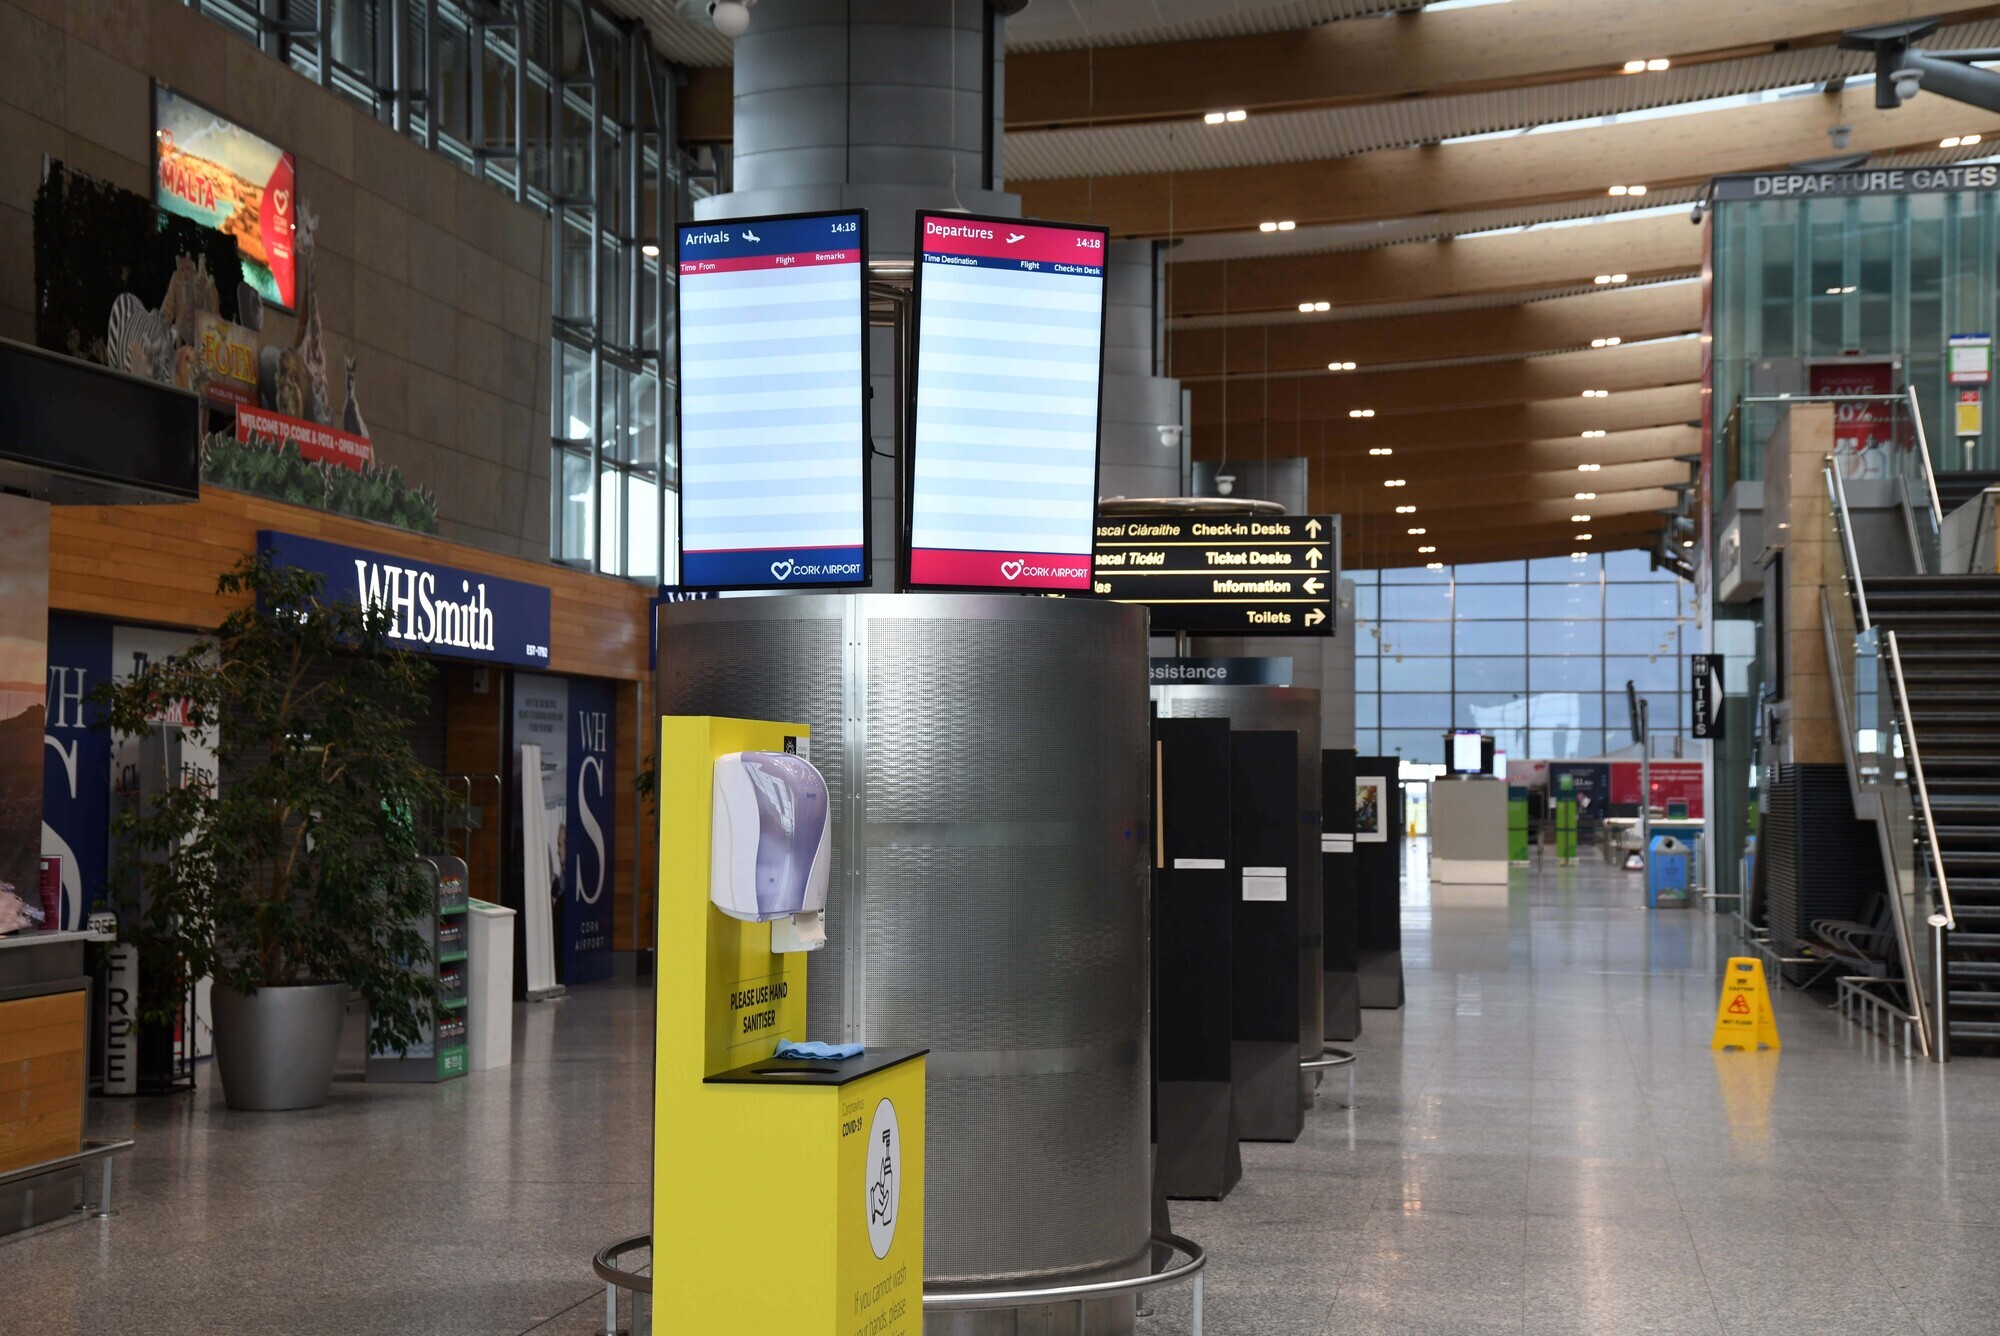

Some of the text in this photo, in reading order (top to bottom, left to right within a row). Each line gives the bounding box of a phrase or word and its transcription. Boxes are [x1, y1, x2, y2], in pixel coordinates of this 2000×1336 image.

[161, 161, 216, 213] MALTA
[1754, 166, 1997, 196] DEPARTURE GATES
[685, 222, 857, 245] Arrivals 14:18
[926, 222, 1101, 249] Departures 14:18
[680, 252, 845, 272] Time From Flight Remarks
[924, 253, 941, 263] Time
[941, 255, 978, 266] Destination
[1020, 260, 1040, 271] Flight
[1084, 266, 1101, 276] Desk
[203, 333, 256, 384] FOTA
[1835, 402, 1873, 422] 0%
[240, 412, 279, 434] WELCOME
[279, 421, 290, 437] TO
[291, 424, 312, 444] CORK
[318, 432, 335, 450] FOTA
[1128, 524, 1181, 536] Ciáraithe
[1192, 523, 1248, 536] Check-in
[1251, 523, 1291, 535] Desks
[793, 564, 861, 576] CORK AIRPORT
[1205, 552, 1247, 565] Ticket
[1250, 552, 1292, 565] Desks
[1022, 567, 1088, 579] CORK AIRPORT
[1213, 580, 1291, 594] Information
[355, 559, 495, 652] WHSmith
[1247, 610, 1291, 624] Toilets
[1694, 678, 1706, 736] LIFTS
[579, 711, 607, 752] WH
[576, 755, 605, 904] S
[730, 981, 788, 1011] PLEASE USE HAND
[742, 1009, 776, 1035] SANITISER
[842, 1098, 864, 1116] Coronavirus
[842, 1117, 863, 1137] COVID-19
[854, 1260, 907, 1316] If you cannot wash
[889, 1296, 907, 1329] please
